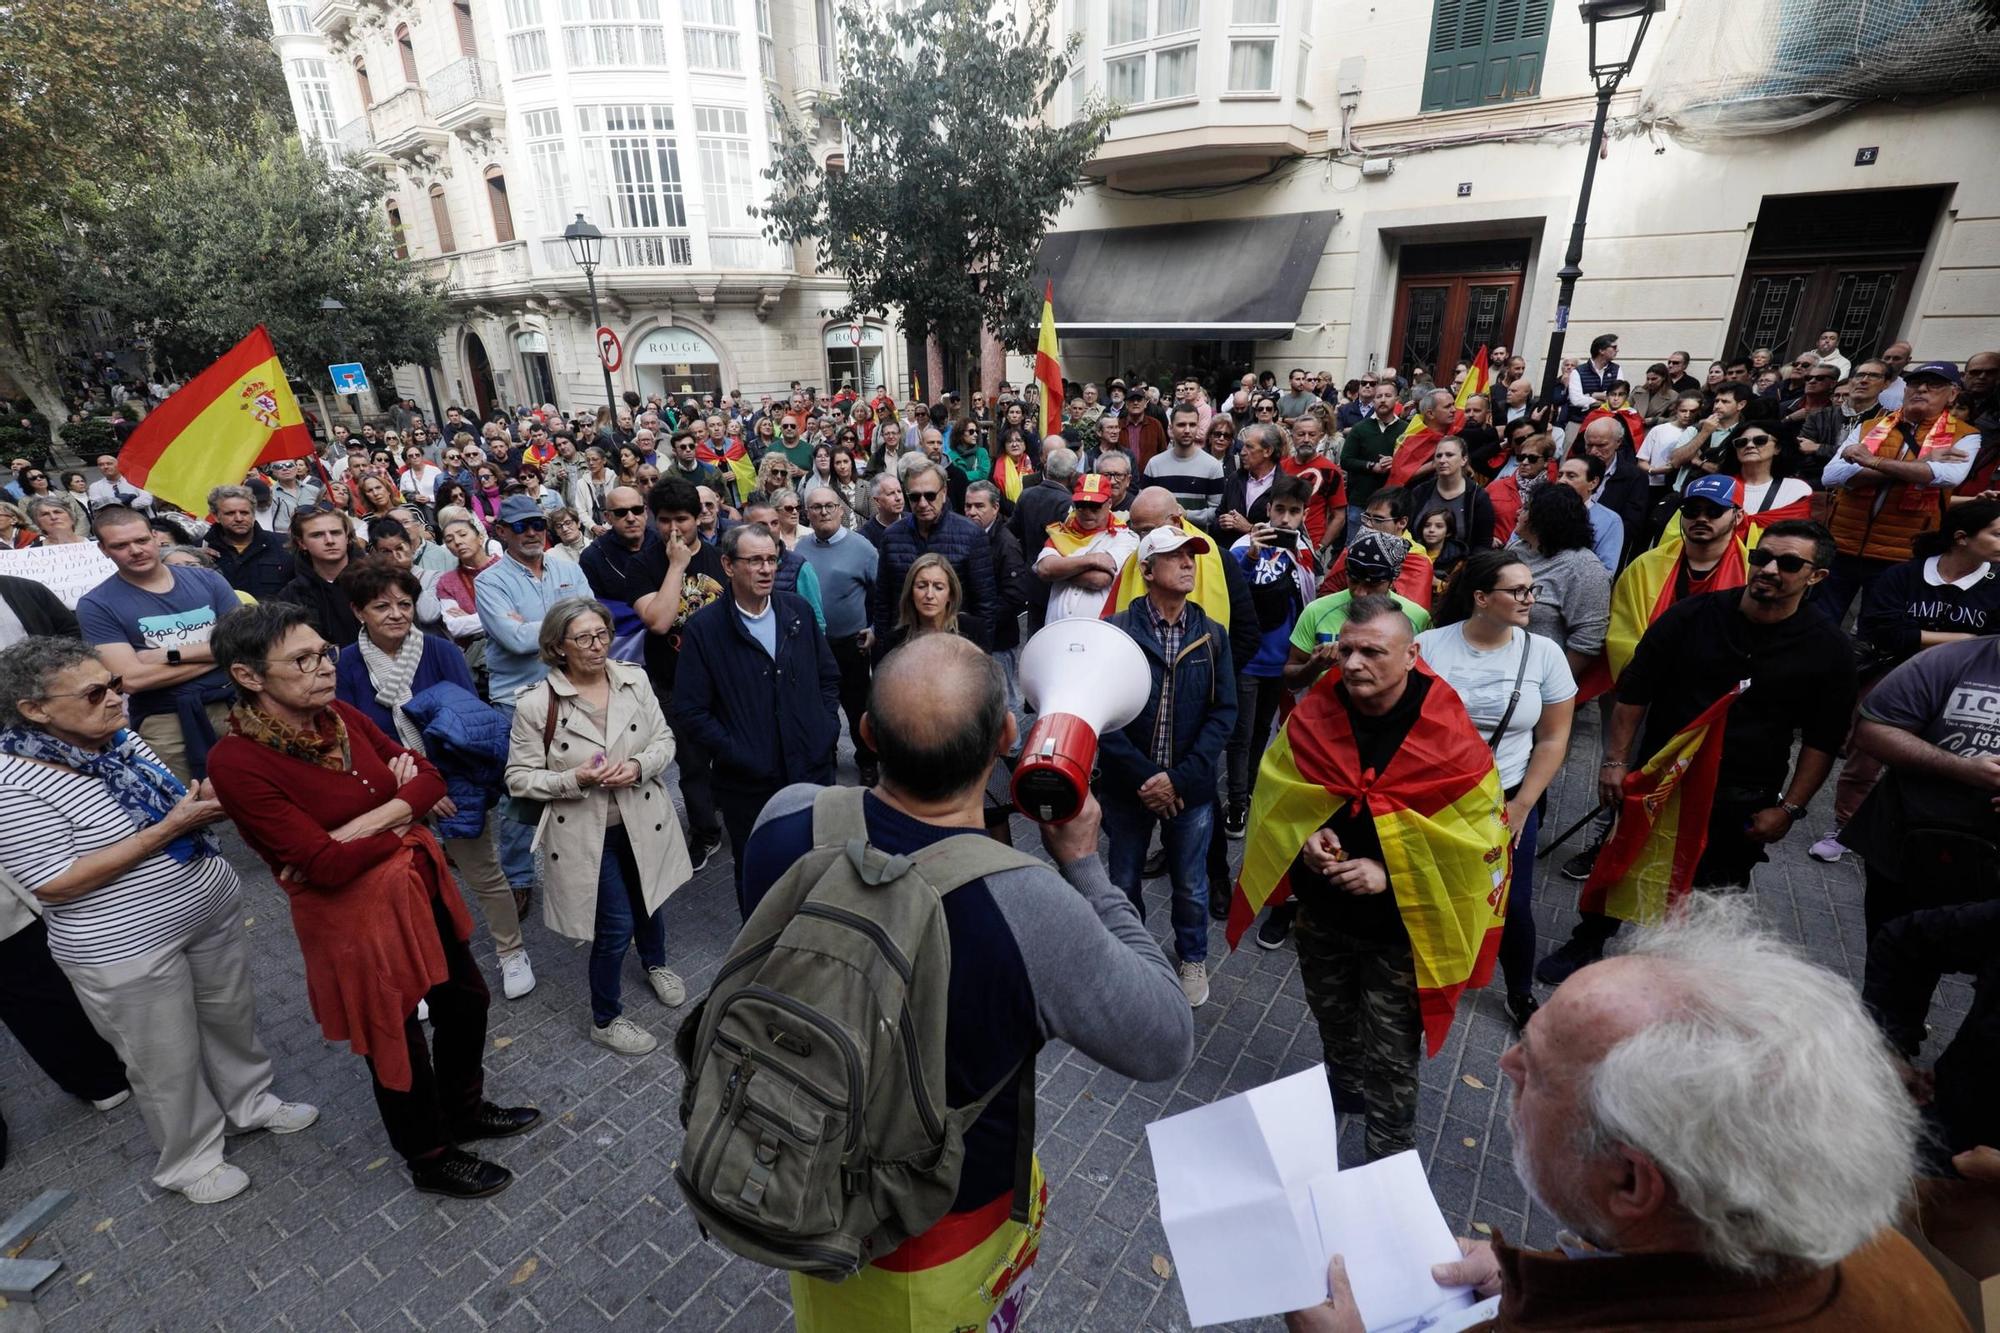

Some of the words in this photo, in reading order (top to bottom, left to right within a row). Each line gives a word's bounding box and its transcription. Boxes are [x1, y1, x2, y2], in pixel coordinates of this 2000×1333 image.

[835, 331, 874, 342] ROGE
[649, 342, 702, 353] ROUGE
[1905, 600, 1987, 628] AMPTONS
[139, 623, 176, 642] Pepe
